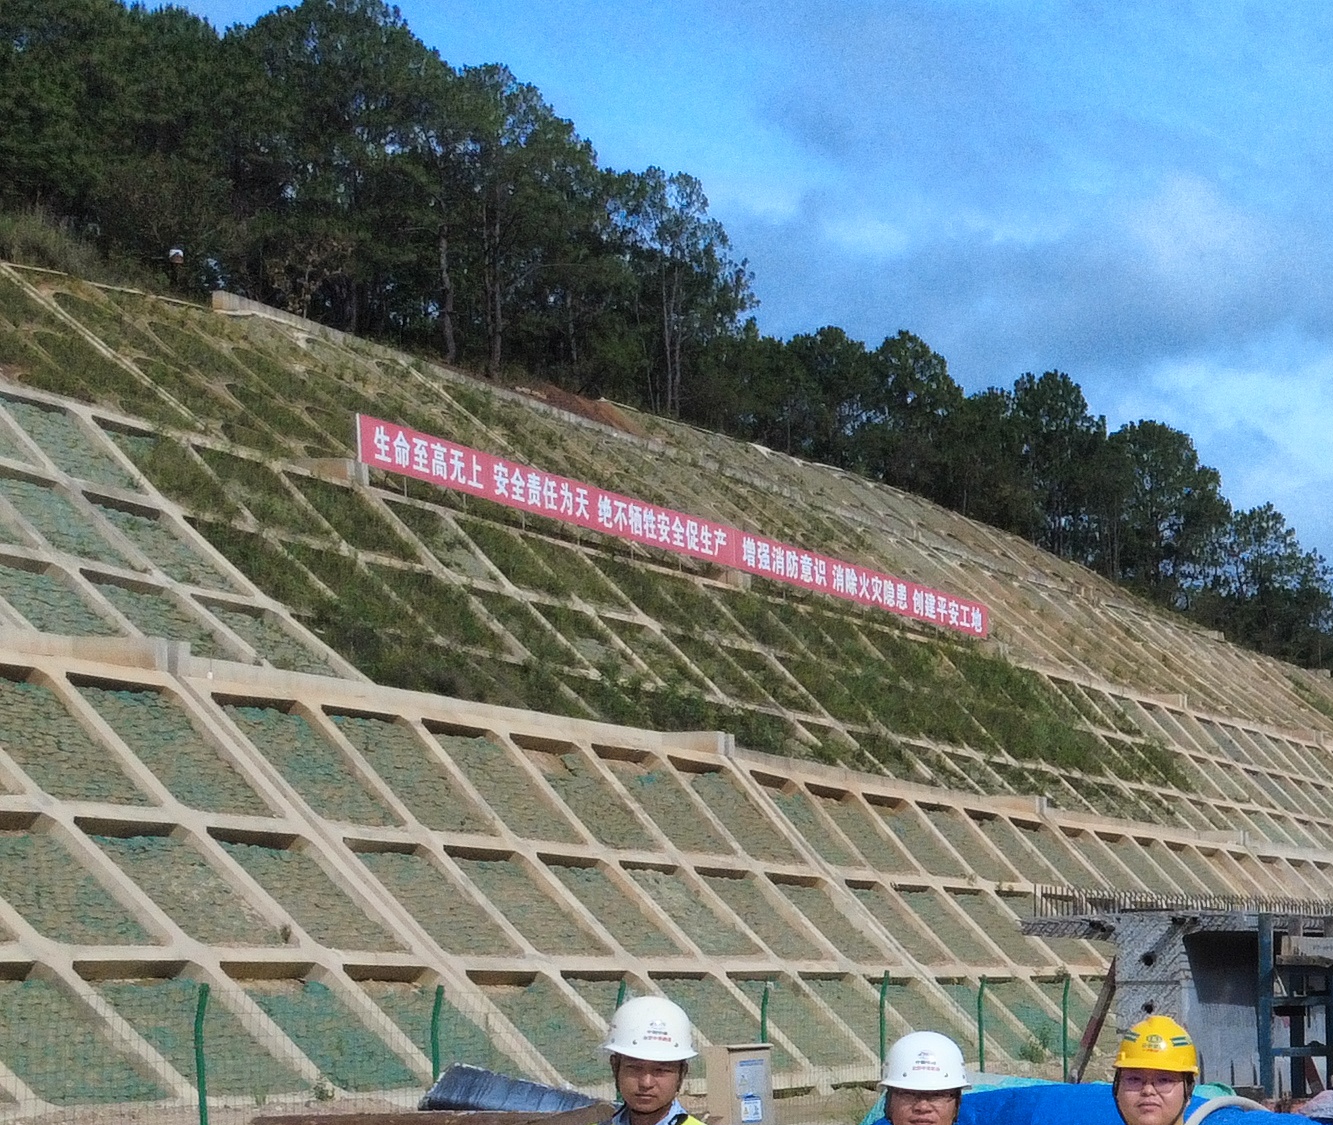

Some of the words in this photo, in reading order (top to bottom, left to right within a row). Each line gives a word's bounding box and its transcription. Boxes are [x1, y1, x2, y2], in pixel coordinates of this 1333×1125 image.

[373, 425, 484, 490] 生命至高无上
[493, 462, 590, 519] 安全责任为天
[597, 494, 727, 556] 绝不牺牲安全促生产
[741, 536, 828, 586] 增强消防意识
[831, 564, 908, 611] 消除火灾隐患
[912, 588, 983, 633] 创建平安工地
